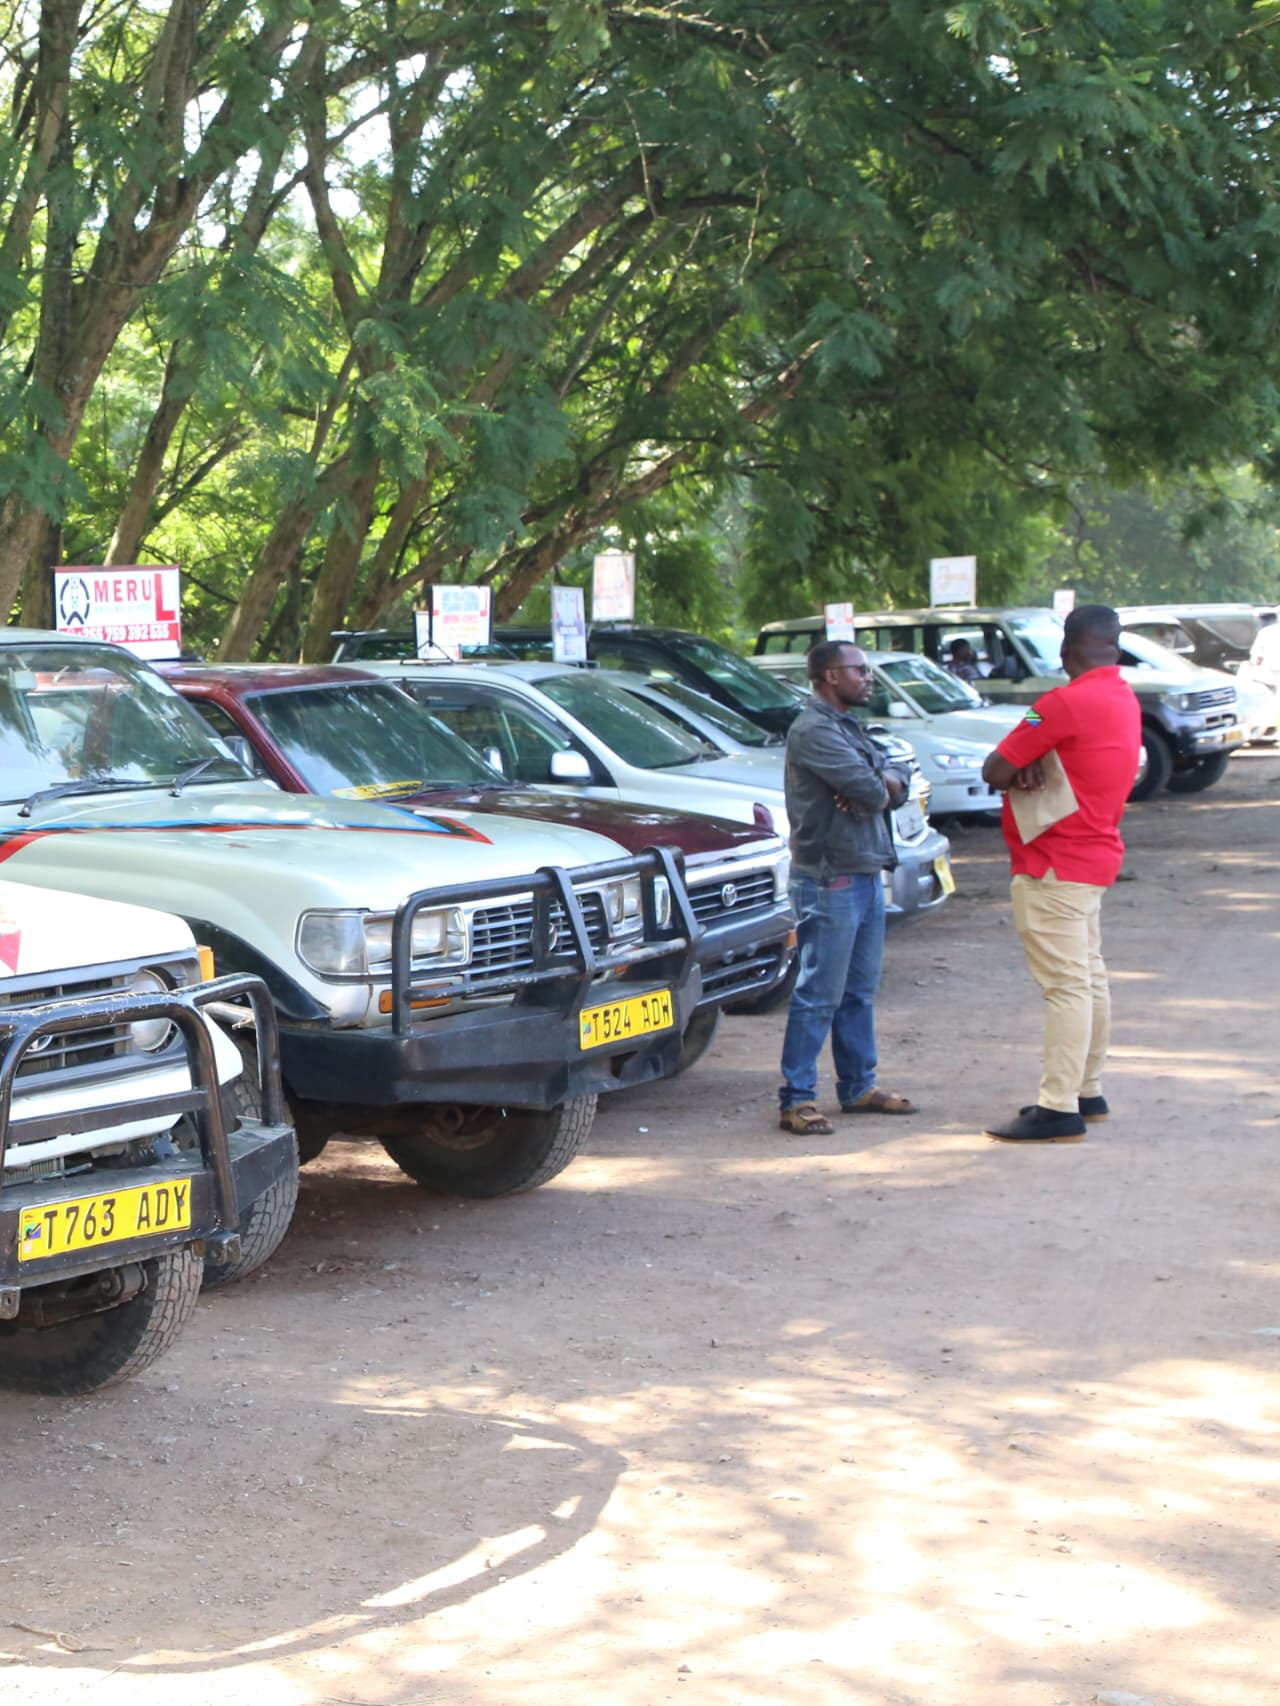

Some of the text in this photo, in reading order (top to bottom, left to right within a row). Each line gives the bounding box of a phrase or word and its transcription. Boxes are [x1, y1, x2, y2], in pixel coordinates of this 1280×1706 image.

[94, 579, 152, 602] MERU
[592, 1004, 631, 1041] T524
[43, 1183, 187, 1250] T763 ADY
